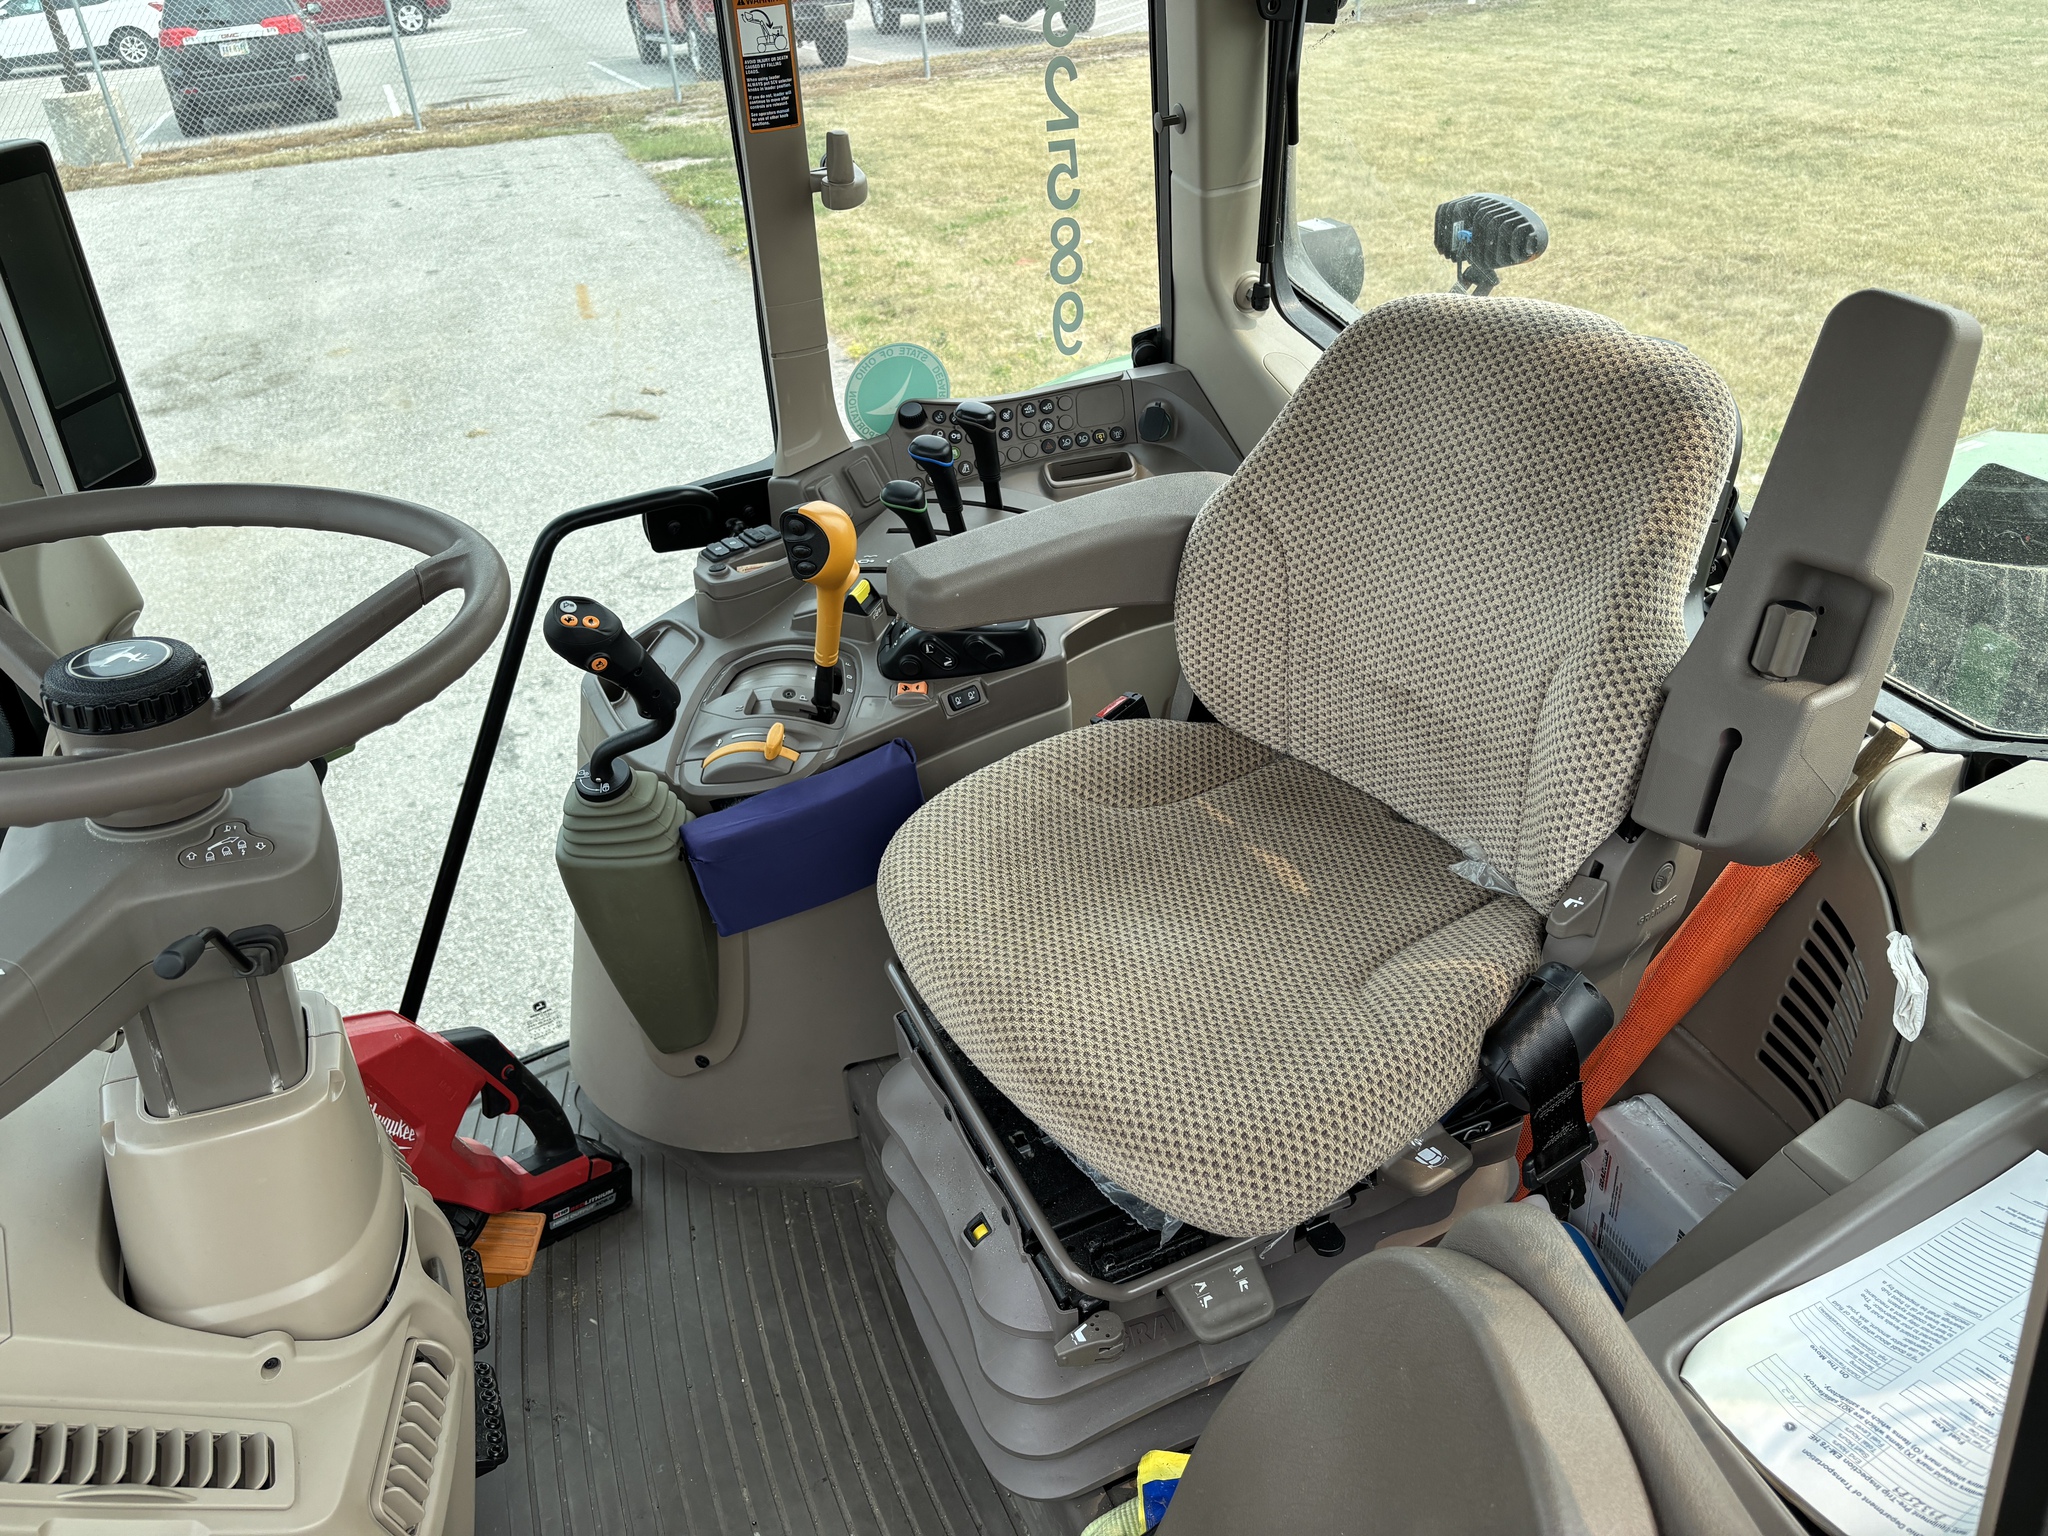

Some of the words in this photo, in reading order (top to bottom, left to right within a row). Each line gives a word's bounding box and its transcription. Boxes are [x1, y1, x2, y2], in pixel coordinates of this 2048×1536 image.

[1830, 1299, 1845, 1311] fluid
[1859, 1292, 1871, 1303] The
[1862, 1287, 1890, 1309] mechanic
[1889, 1293, 1905, 1305] front
[1892, 1288, 1920, 1307] inspected
[1844, 1303, 1861, 1315] your
[1869, 1308, 1885, 1320] shall
[1892, 1310, 1908, 1320] want
[1848, 1314, 1863, 1326] type
[1898, 1321, 1914, 1330] your
[1860, 1324, 1876, 1336] what
[1868, 1322, 1892, 1339] amount,
[1873, 1333, 1892, 1346] about
[1807, 1344, 1827, 1361] Move
[1888, 1343, 1907, 1354] doubt
[1825, 1358, 1839, 1370] The
[1837, 1369, 1850, 1379] On
[1800, 1372, 1839, 1404] satisfactory.
[1821, 1383, 1861, 1409] satisfactory.
[1851, 1410, 1865, 1420] are
[1858, 1405, 1872, 1416] are
[1967, 1397, 1996, 1418] Wheels
[1862, 1418, 1885, 1435] which
[1869, 1414, 1892, 1431] which
[1930, 1418, 1949, 1434] Area
[1807, 1432, 1821, 1443] HE
[1843, 1426, 1862, 1441] Hours
[1853, 1423, 1872, 1438] Level
[1890, 1429, 1912, 1446] items
[1836, 1432, 1855, 1448] Hours
[1860, 1439, 1877, 1453] Total
[1869, 1434, 1885, 1448] Fuel
[1883, 1434, 1905, 1451] items
[1946, 1431, 1966, 1446] Fuel
[1818, 1440, 1843, 1460] EM-78
[1830, 1439, 1850, 1455] Hours
[1852, 1445, 1870, 1459] Start
[1847, 1452, 1863, 1464] End
[1914, 1457, 1934, 1473] mark
[1922, 1453, 1942, 1468] mark
[1800, 1448, 1853, 1490] Transportation
[1840, 1457, 1882, 1490] Inspection
[1939, 1465, 1967, 1482] should
[1931, 1469, 1959, 1487] should
[1850, 1487, 1863, 1498] of
[1879, 1487, 1913, 1513] Pre-Trip
[1860, 1495, 1907, 1530] Department
